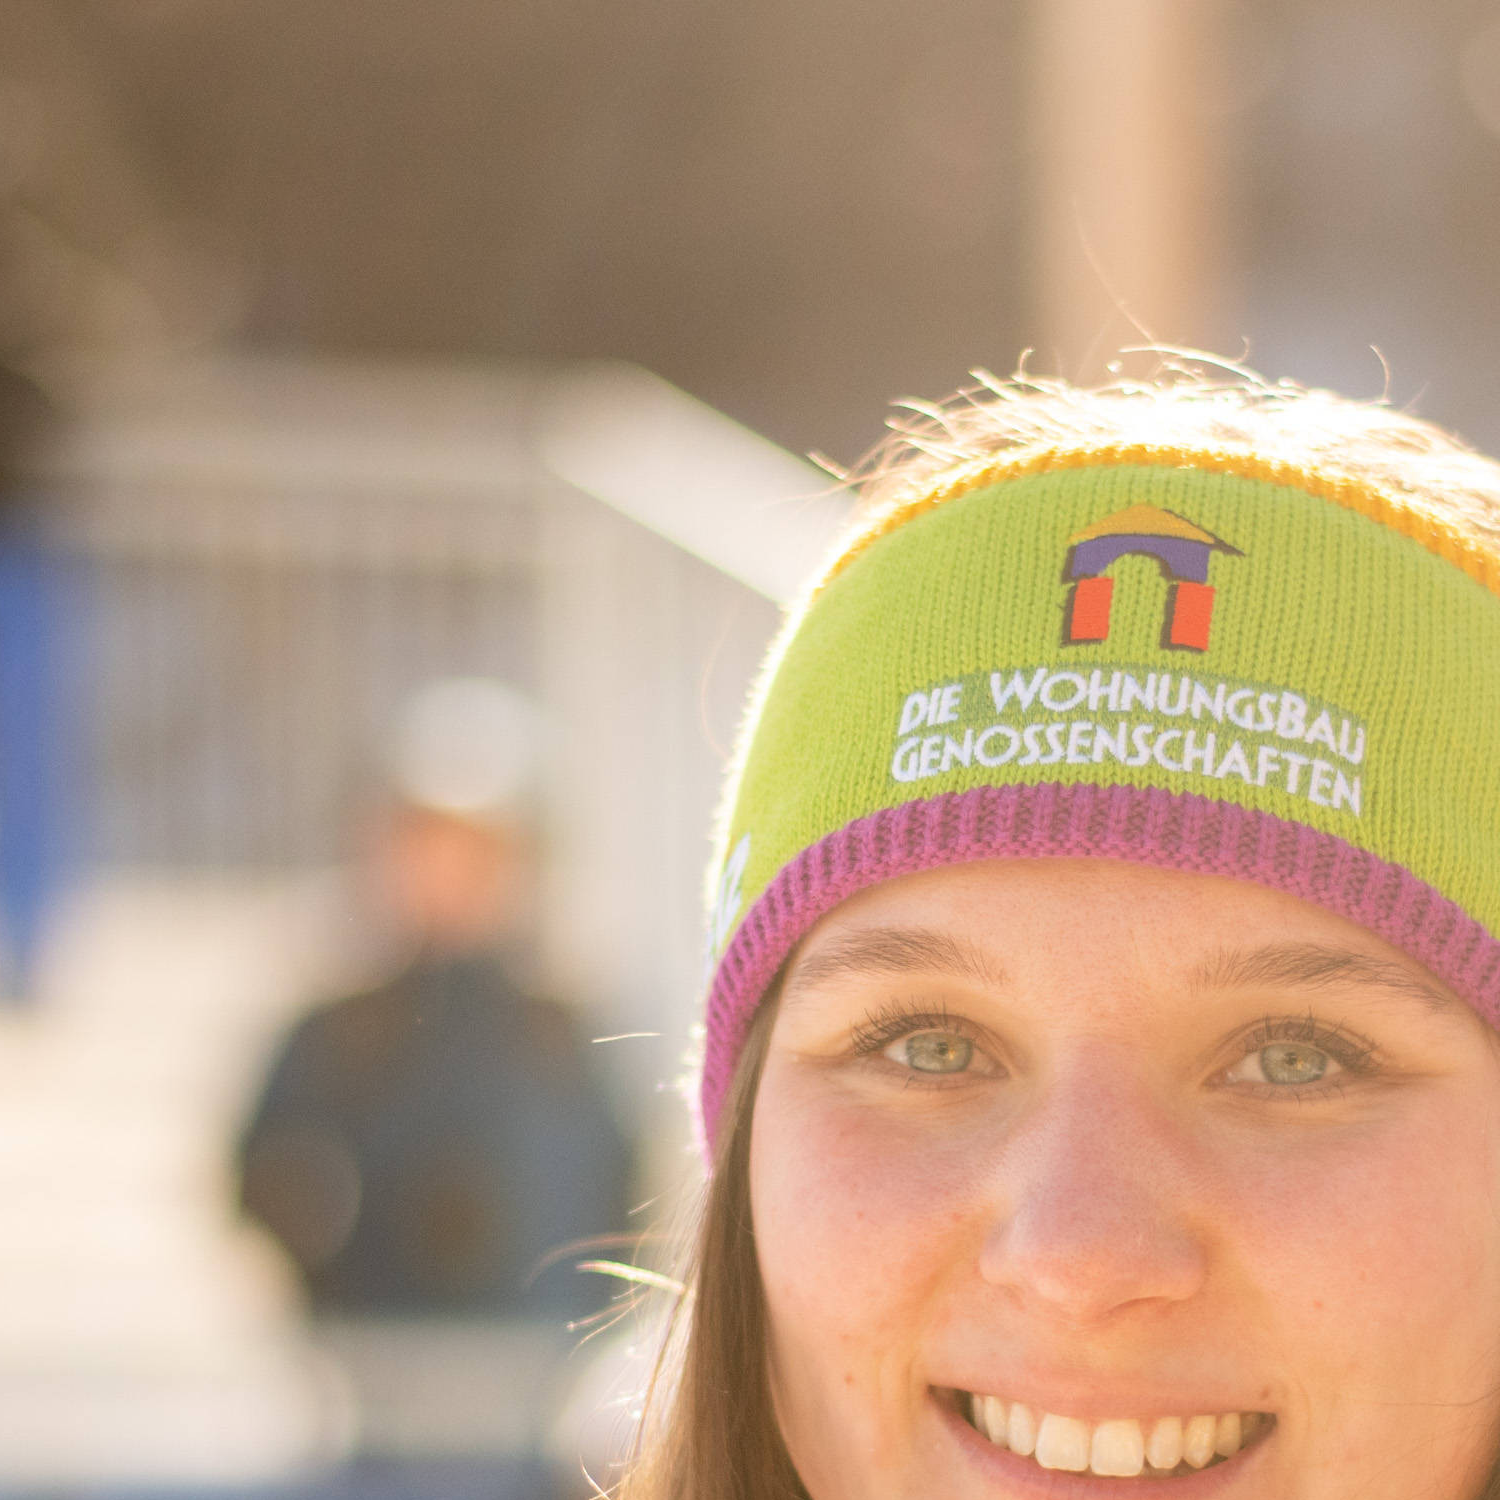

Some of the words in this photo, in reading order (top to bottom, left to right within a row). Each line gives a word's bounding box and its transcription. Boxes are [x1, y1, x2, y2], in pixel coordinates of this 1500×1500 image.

[898, 683, 962, 737] DIE
[990, 667, 1365, 765] WOHNUNGSBAU
[891, 721, 1362, 818] GENOSSENSCHAFTEN
